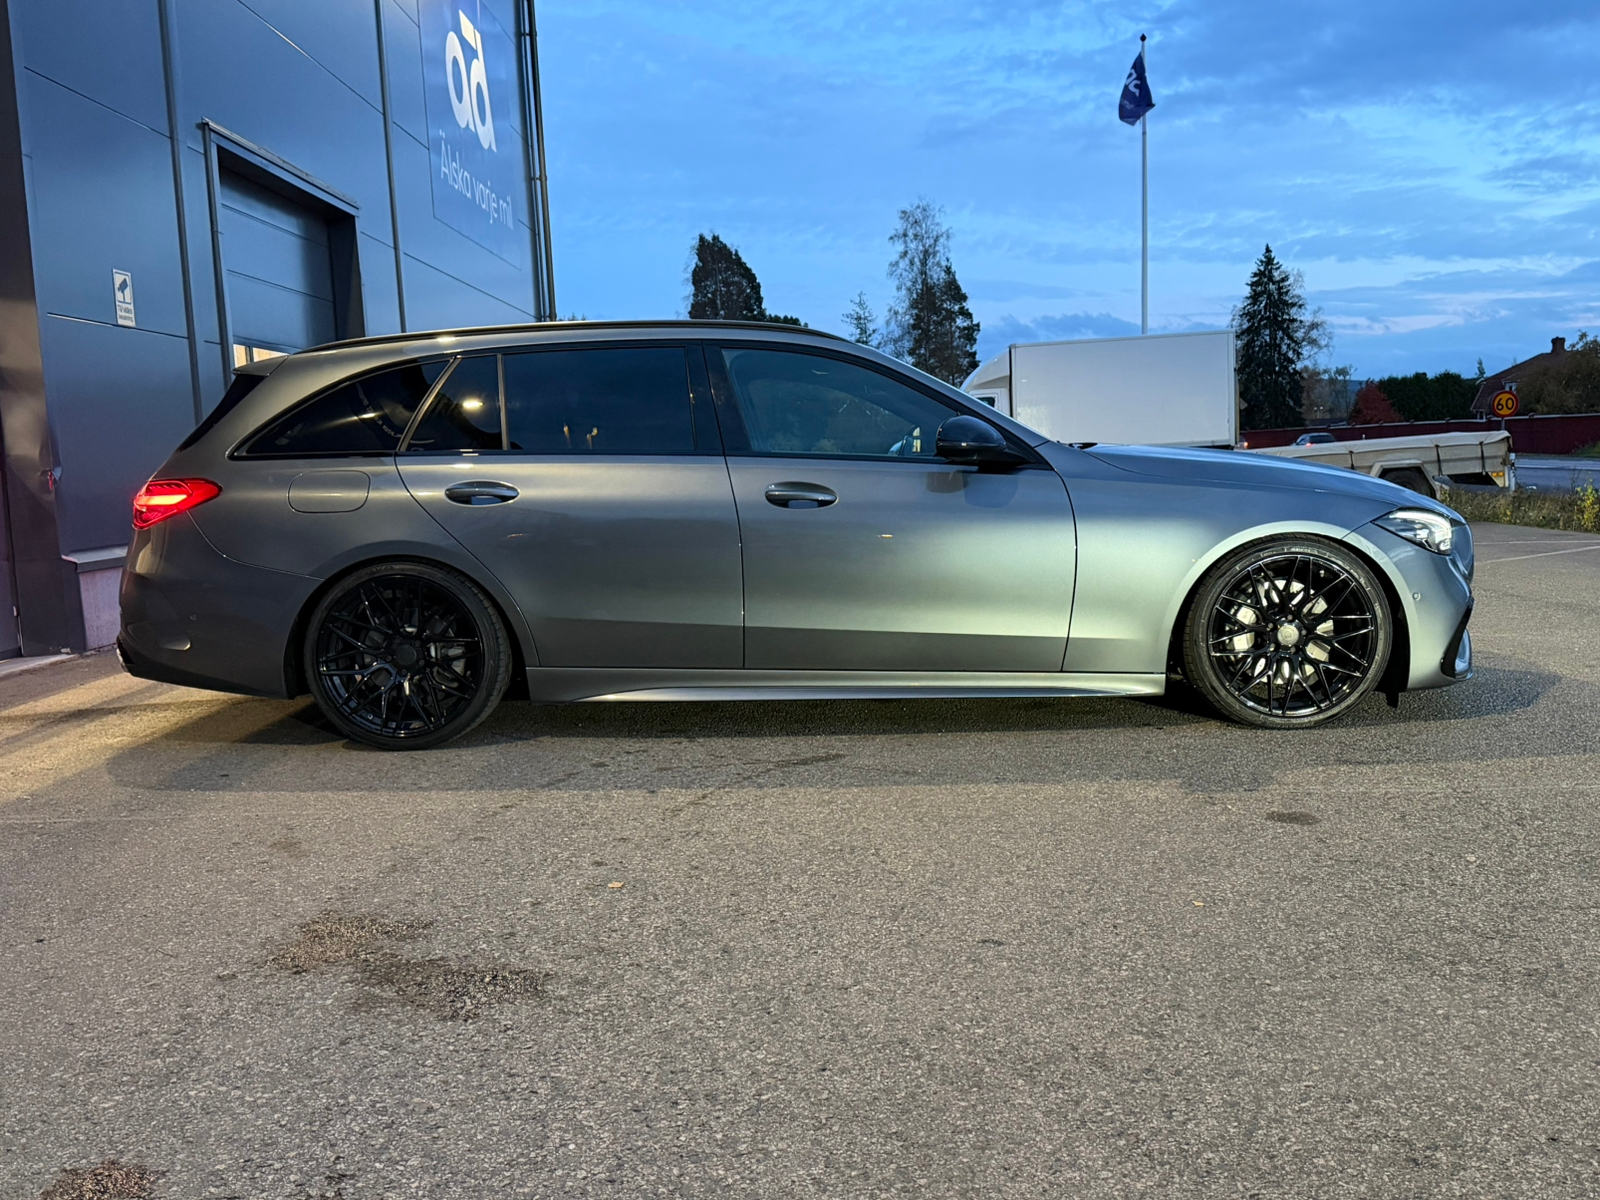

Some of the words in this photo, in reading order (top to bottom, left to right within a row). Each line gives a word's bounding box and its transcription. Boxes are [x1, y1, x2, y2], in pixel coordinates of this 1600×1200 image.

[439, 129, 471, 199] Älska
[472, 177, 498, 225] varje
[499, 194, 514, 230] mil
[1496, 397, 1515, 412] 60
